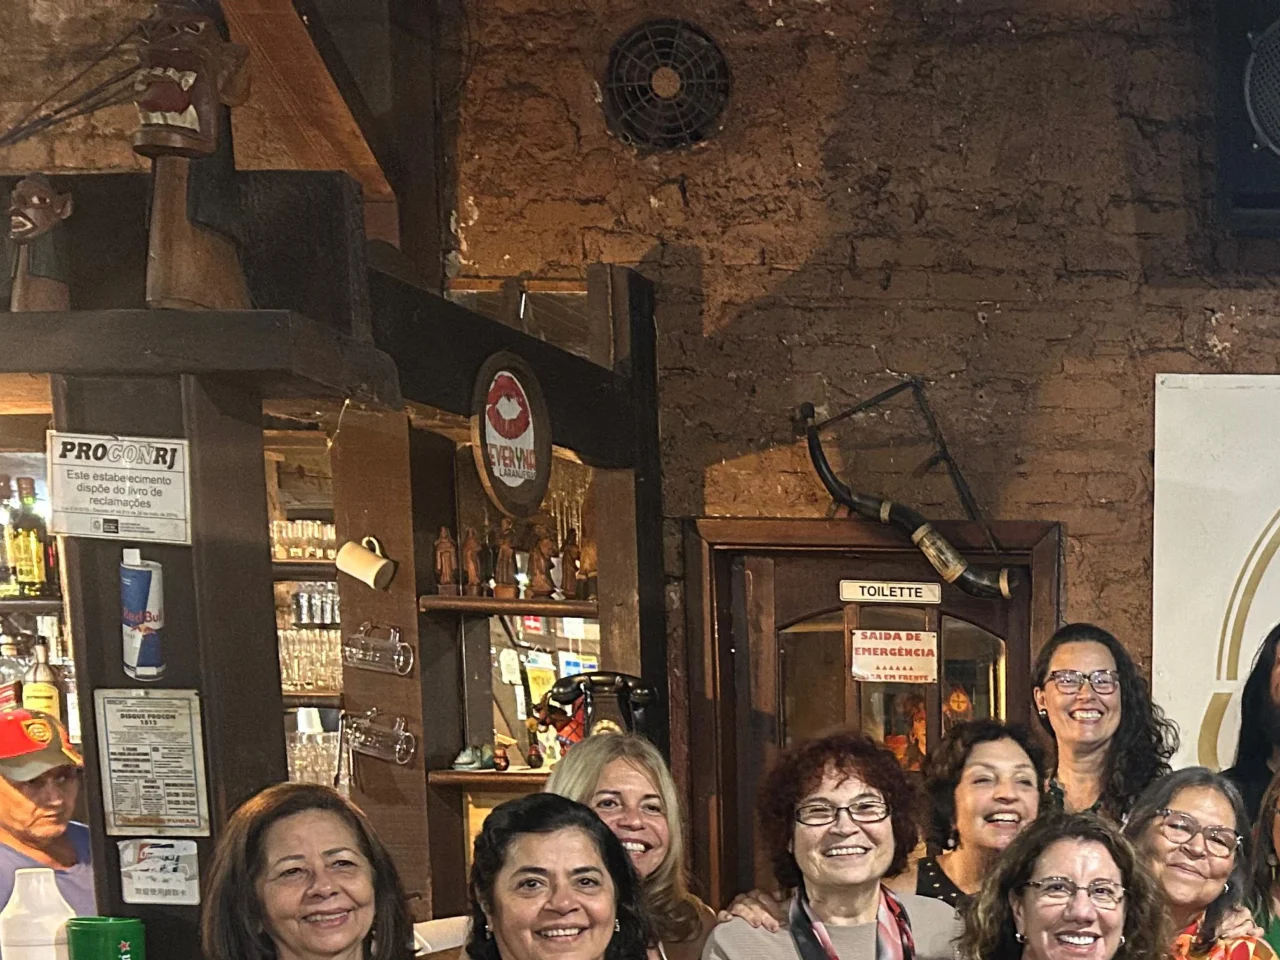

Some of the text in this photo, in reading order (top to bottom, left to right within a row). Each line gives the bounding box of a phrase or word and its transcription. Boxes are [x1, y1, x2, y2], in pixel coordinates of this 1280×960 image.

[66, 469, 90, 480] Este
[77, 483, 163, 497] dispõe do livro de
[89, 496, 152, 509] reclamações
[858, 585, 923, 598] TOILETTE
[122, 607, 143, 622] Red
[905, 633, 922, 641] DE
[854, 646, 935, 657] EMERGÊNCIA
